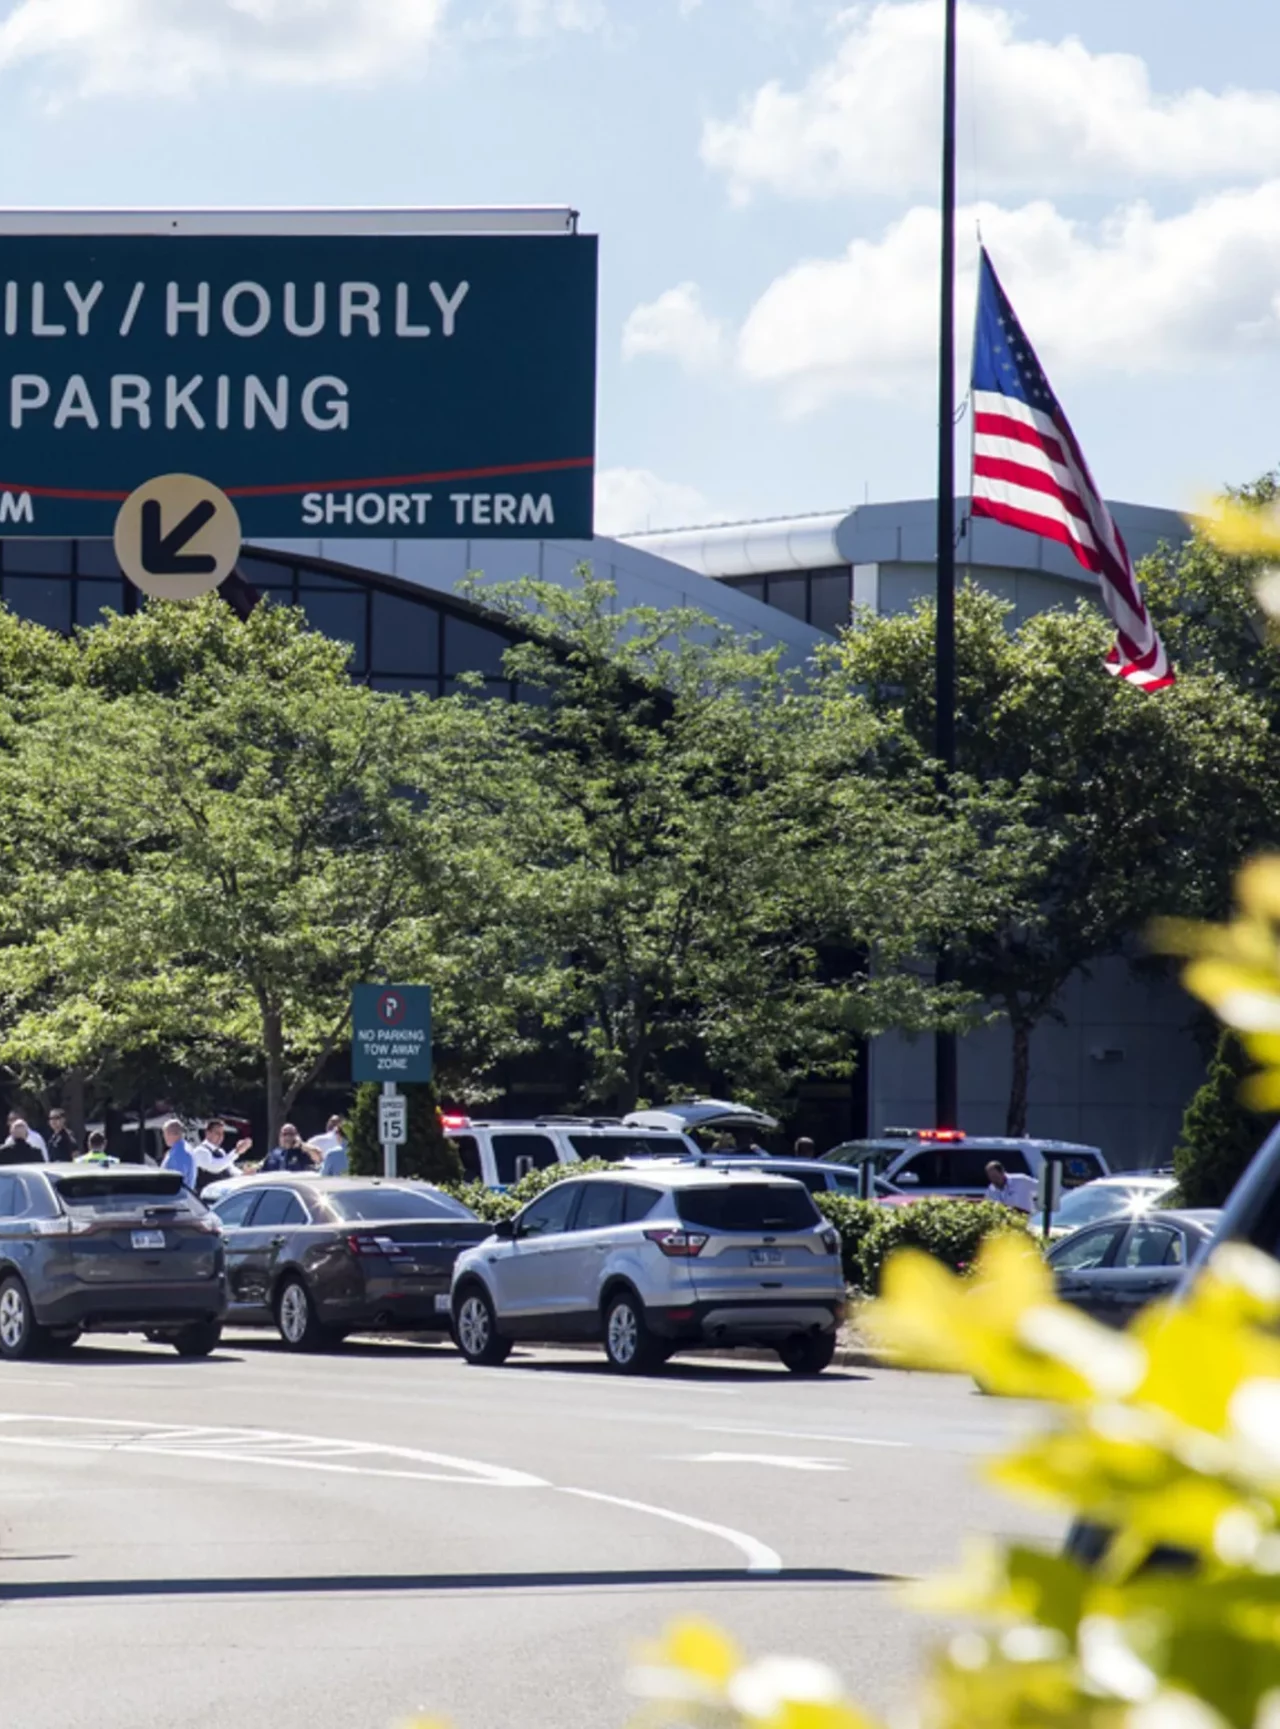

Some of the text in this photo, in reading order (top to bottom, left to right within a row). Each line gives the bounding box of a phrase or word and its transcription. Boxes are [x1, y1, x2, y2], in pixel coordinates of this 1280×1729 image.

[10, 374, 351, 431] PARKING
[301, 492, 554, 525] SHORT TERM
[358, 1029, 425, 1041] NO PARKING
[363, 1043, 421, 1055] TOW AWAY
[377, 1058, 408, 1069] ZONE
[383, 1121, 402, 1138] 15
